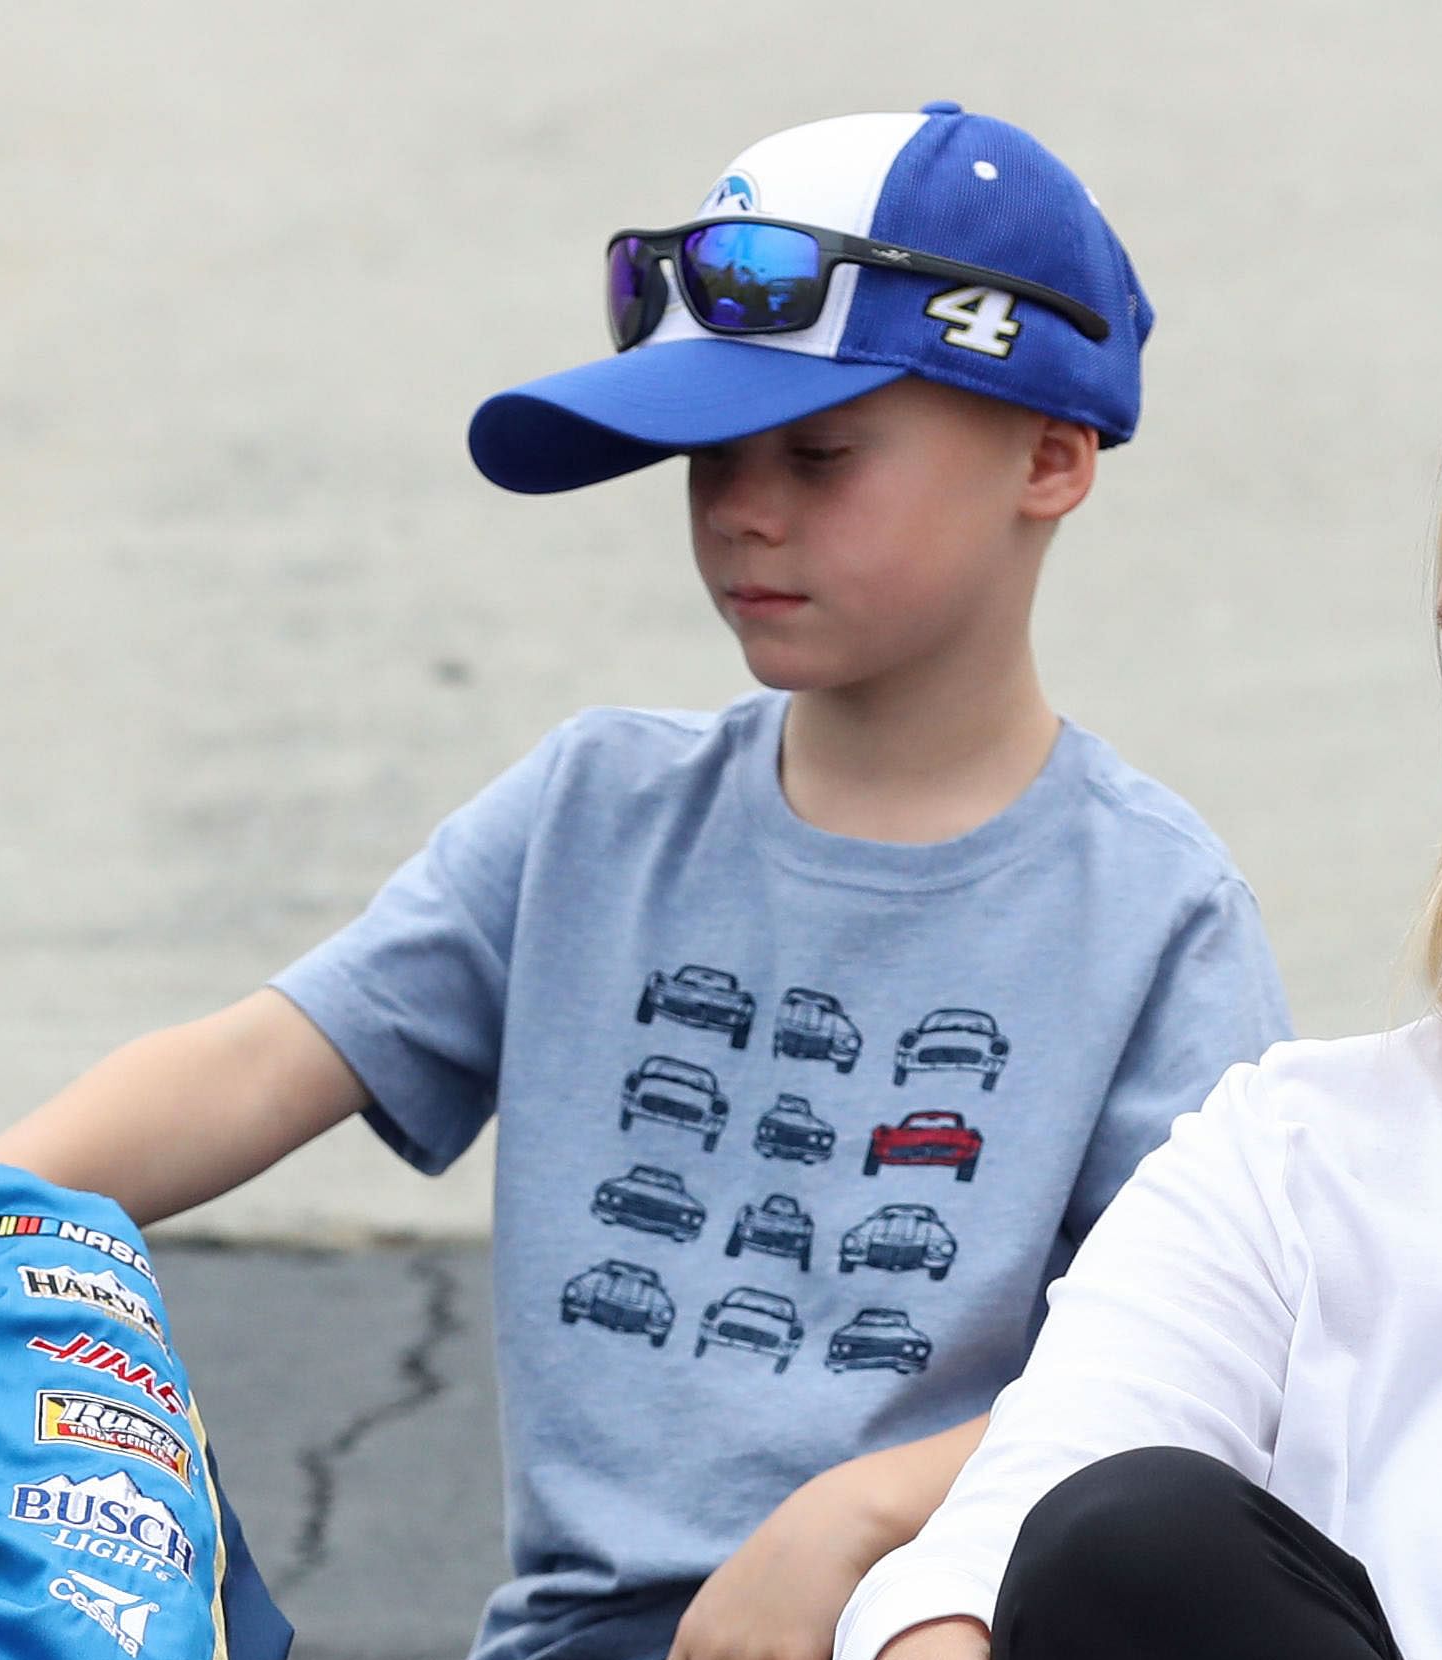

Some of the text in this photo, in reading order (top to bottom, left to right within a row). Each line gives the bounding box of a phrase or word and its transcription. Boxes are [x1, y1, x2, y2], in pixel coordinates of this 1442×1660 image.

[924, 287, 1020, 358] 4
[31, 1335, 179, 1414] HAAS
[13, 1485, 194, 1577] BUSCH
[51, 1528, 165, 1573] LIGHT
[48, 1577, 141, 1658] Cessna
